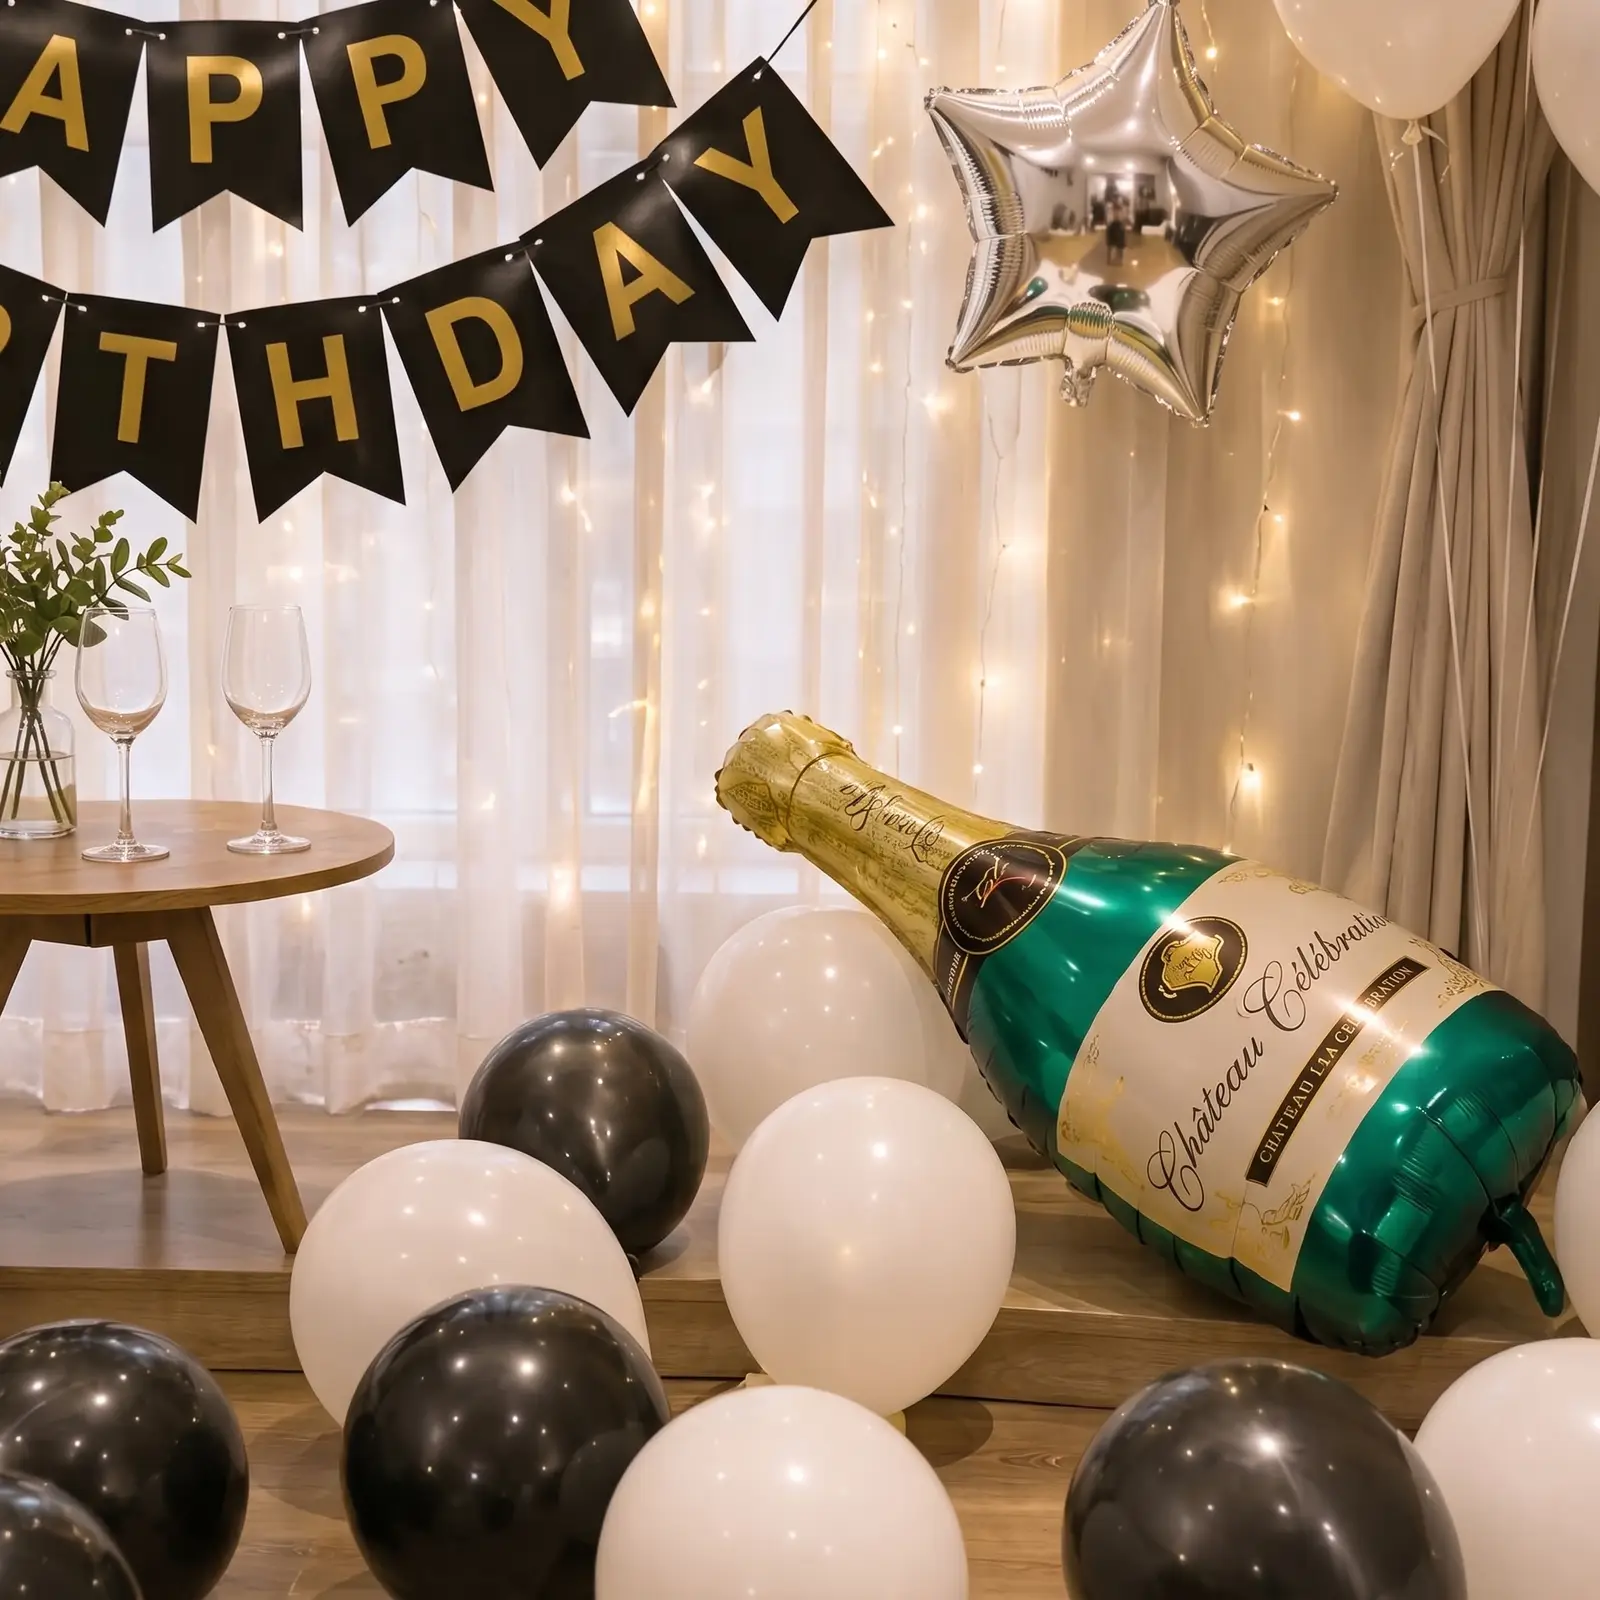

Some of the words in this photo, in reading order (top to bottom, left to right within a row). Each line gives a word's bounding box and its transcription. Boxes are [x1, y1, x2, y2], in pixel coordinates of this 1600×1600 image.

[0, 108, 800, 450] THDAY
[1147, 1036, 1264, 1211] Château
[1243, 912, 1391, 1032] Célébratio
[1334, 964, 1414, 1043] CELBRATION
